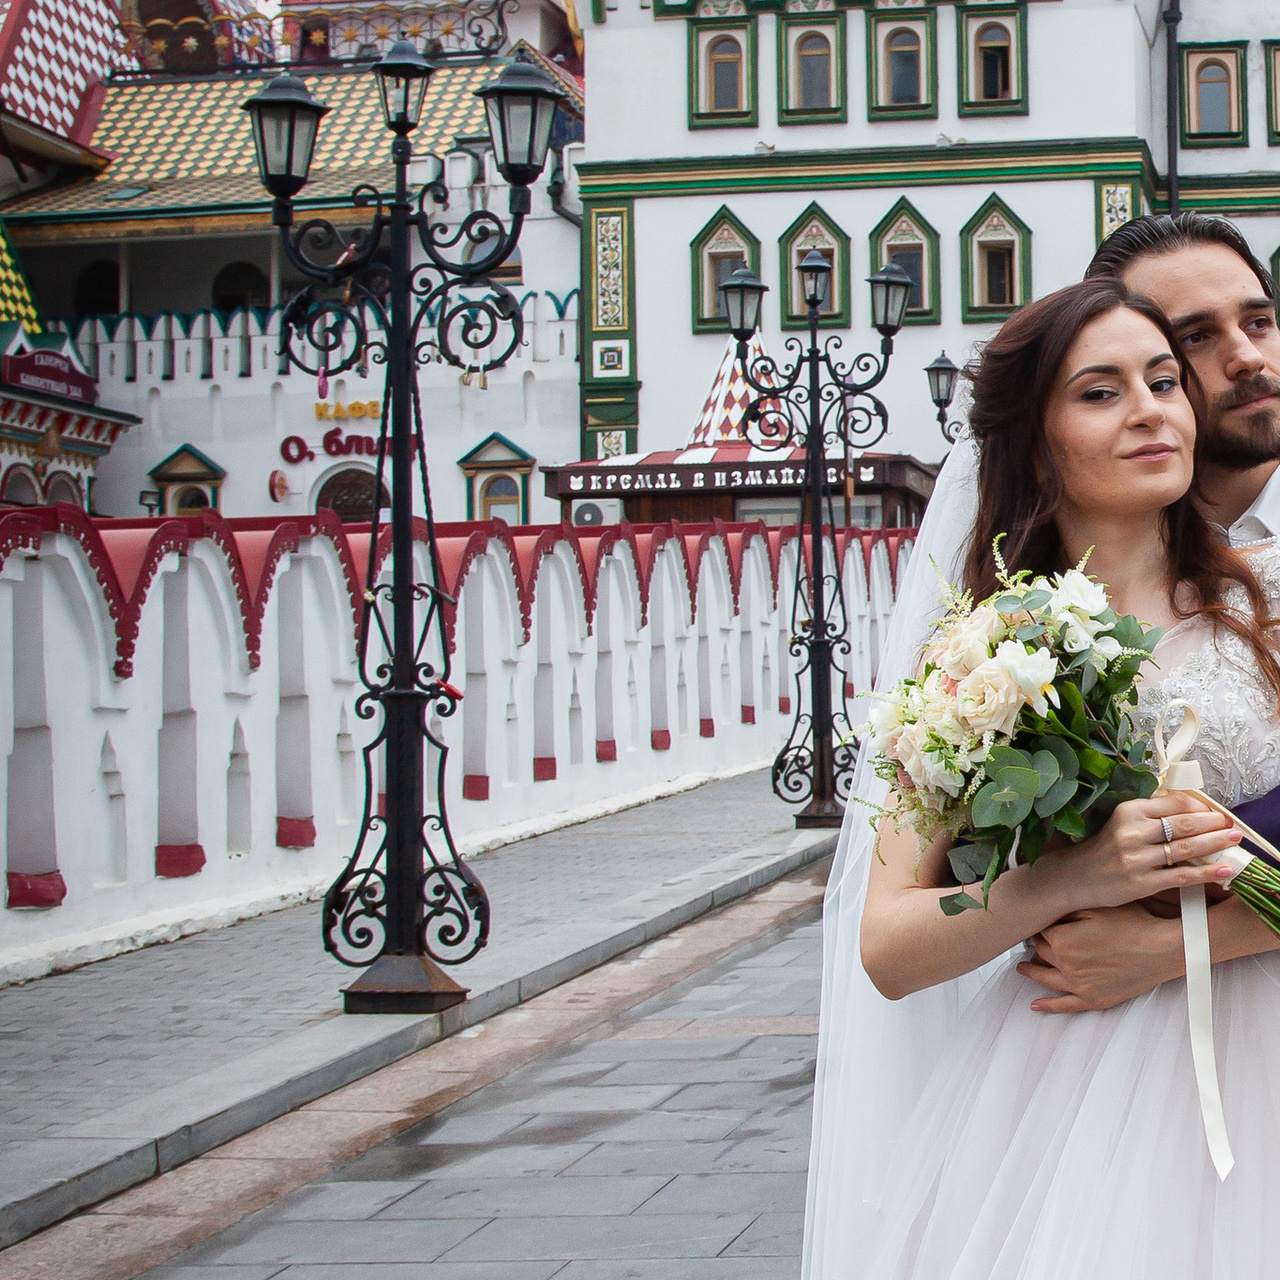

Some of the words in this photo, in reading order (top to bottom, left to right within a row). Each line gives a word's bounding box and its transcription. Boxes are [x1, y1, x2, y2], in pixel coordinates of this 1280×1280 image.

[314, 400, 379, 420] КАФЕ
[590, 473, 682, 490] КРЕМЛЬ
[692, 472, 705, 488] В
[714, 466, 848, 487] ИЗМАЙЛВ
